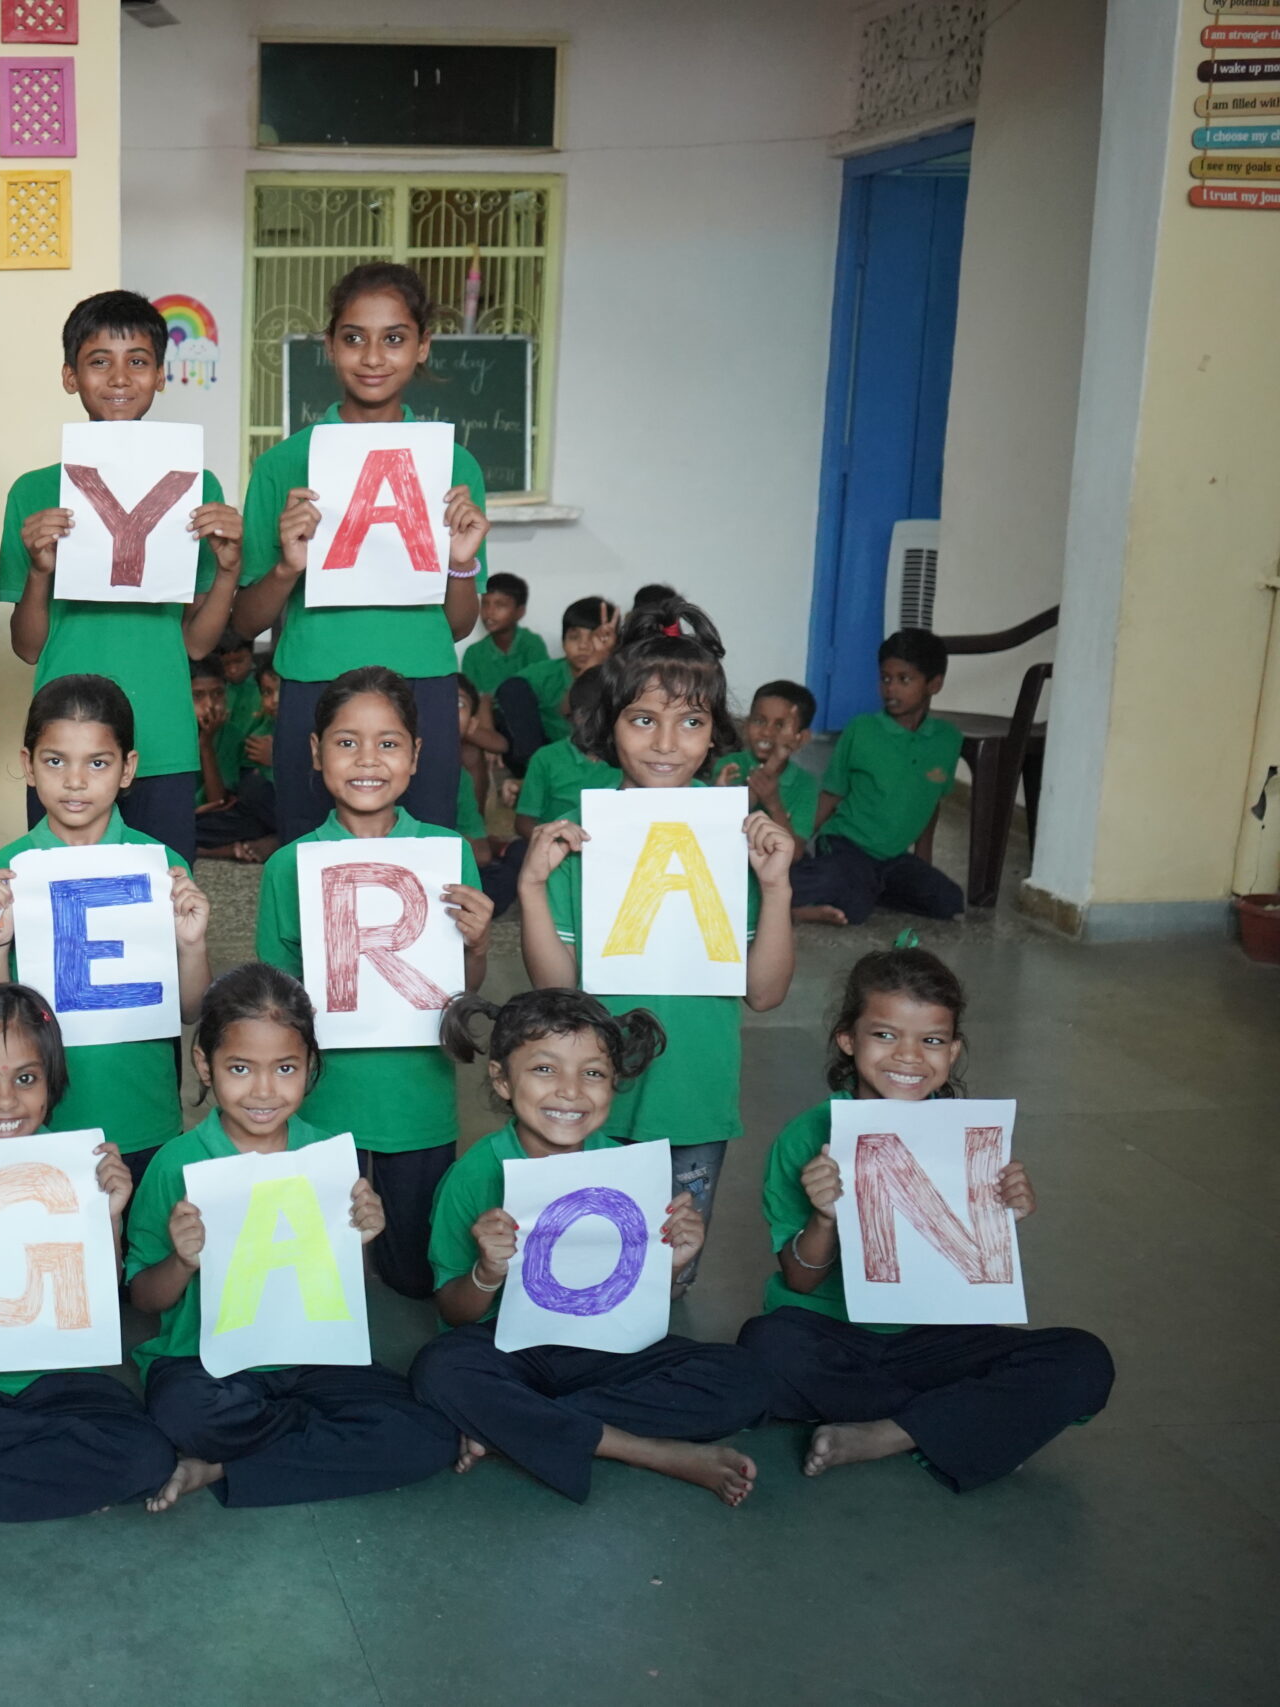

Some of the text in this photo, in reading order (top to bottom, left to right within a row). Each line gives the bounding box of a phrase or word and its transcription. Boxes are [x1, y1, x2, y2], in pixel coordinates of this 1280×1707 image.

[1204, 28, 1209, 40] I
[1211, 32, 1226, 40] am
[1229, 30, 1269, 43] stronger
[1213, 63, 1218, 74] I
[1220, 62, 1247, 74] wake
[1249, 64, 1262, 76] up
[1206, 130, 1210, 142] I
[1213, 130, 1249, 142] choose
[1251, 132, 1269, 144] my
[1212, 101, 1229, 111] am
[1232, 97, 1257, 110] filled
[1203, 188, 1208, 201] I
[1210, 190, 1238, 201] trust
[1241, 193, 1258, 205] my
[1207, 163, 1224, 172] see
[1227, 163, 1242, 175] my
[1245, 161, 1272, 175] goals
[63, 465, 198, 587] Y
[322, 448, 441, 572] A
[53, 875, 163, 1014] E
[321, 862, 453, 1013] R
[602, 822, 741, 963] A
[217, 1178, 352, 1334] A
[519, 1187, 650, 1318] O
[855, 1127, 1014, 1284] N
